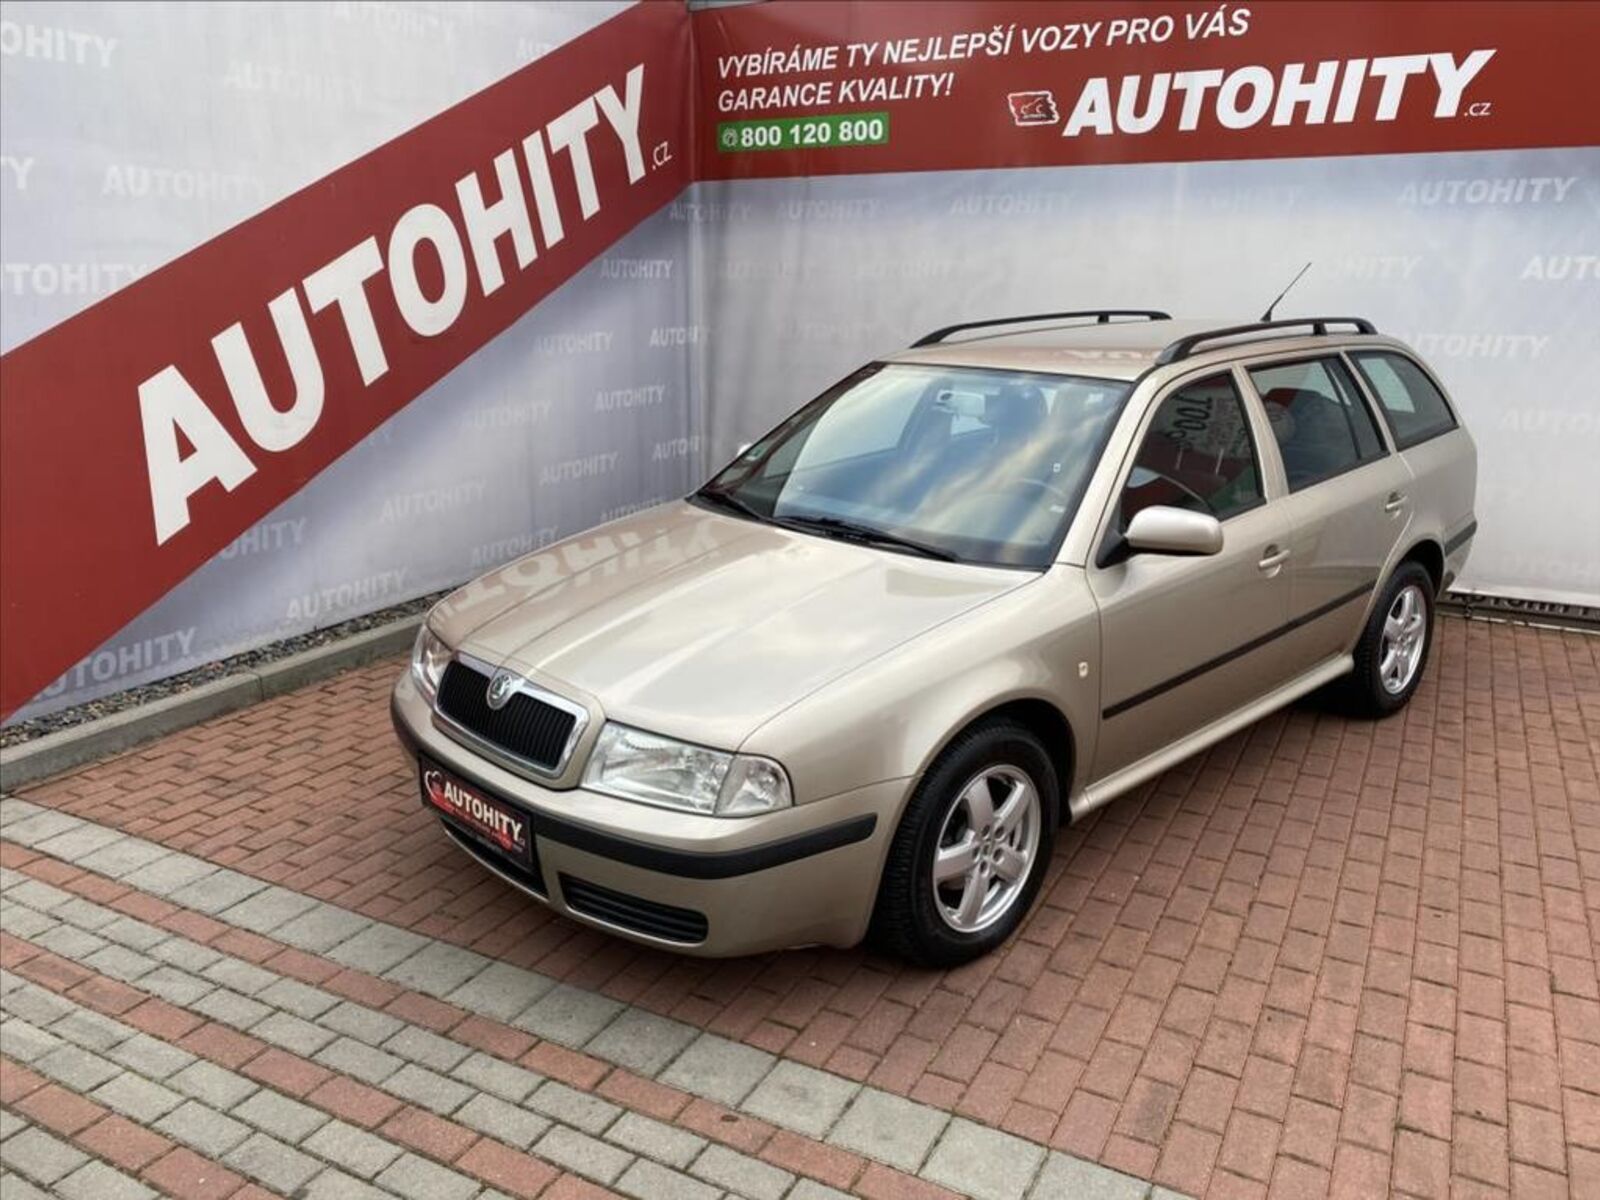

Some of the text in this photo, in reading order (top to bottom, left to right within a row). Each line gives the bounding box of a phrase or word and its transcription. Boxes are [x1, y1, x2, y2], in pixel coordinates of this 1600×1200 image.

[718, 5, 1251, 78] VYBÍRÁME TY NEJLEPŠÍ VOZY PRO VÁS
[718, 71, 955, 112] GARANCE KVALITY!
[1062, 49, 1497, 137] AUTOHITY
[740, 118, 884, 148] 800 120 800
[1397, 176, 1579, 206] AUTOHITY
[602, 257, 674, 281] AUTOHITY
[134, 63, 647, 546] AUTOHITY
[594, 383, 666, 414] AUTOHITY
[539, 452, 619, 487] AUTOHITY
[379, 478, 487, 524] AUTOHITY
[286, 566, 407, 620] AUTOHITY
[444, 781, 522, 842] AUTOHITY
